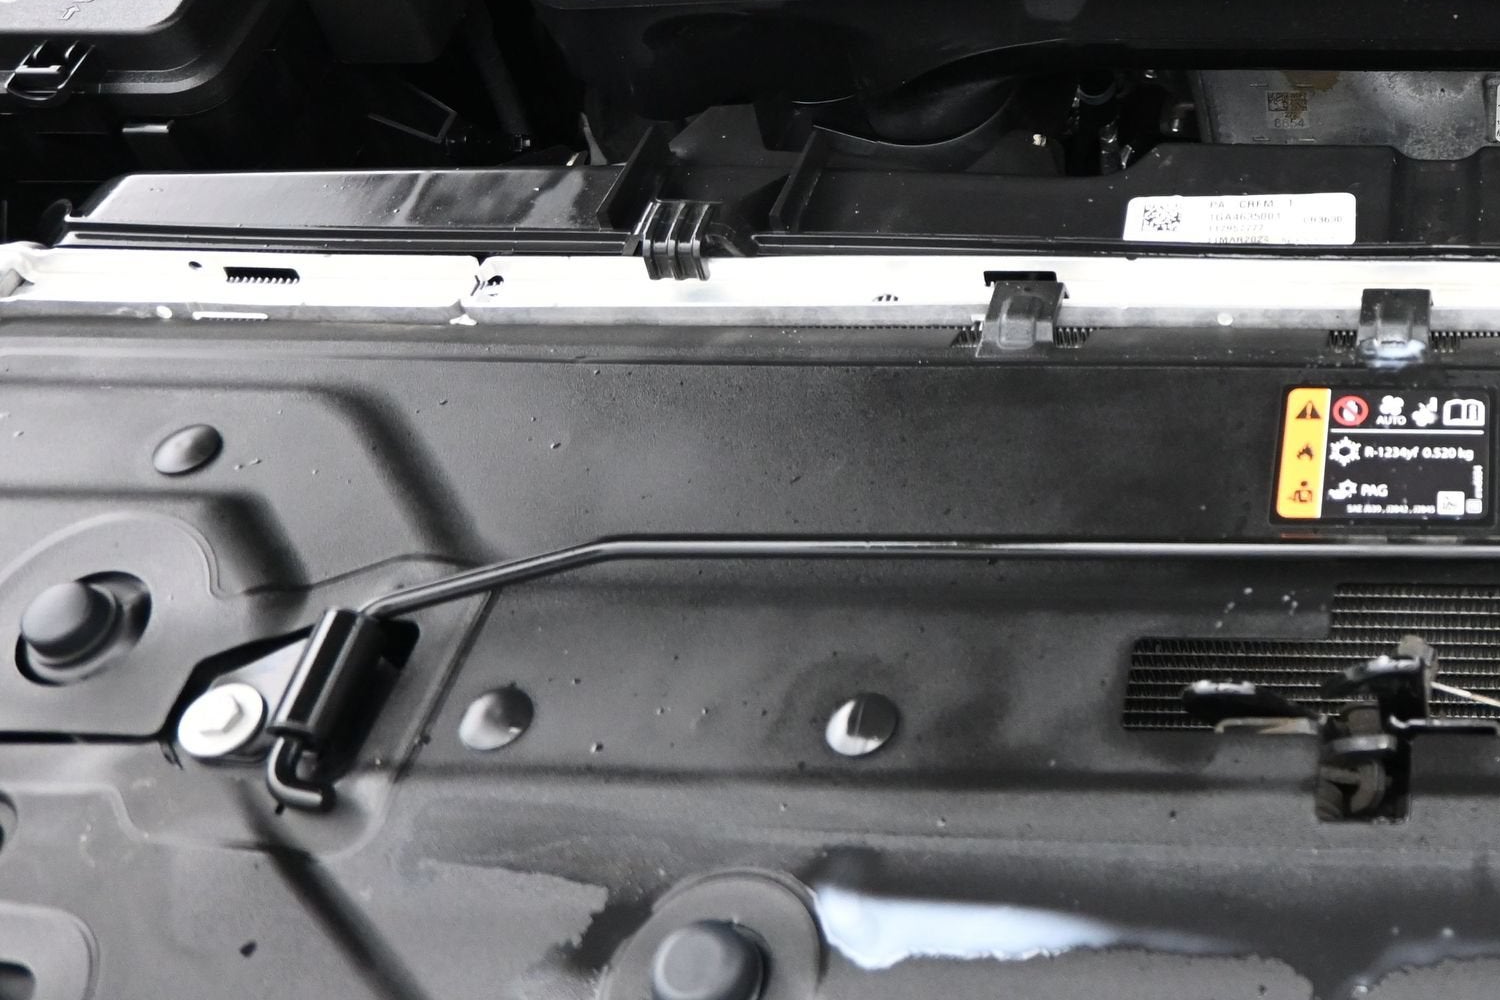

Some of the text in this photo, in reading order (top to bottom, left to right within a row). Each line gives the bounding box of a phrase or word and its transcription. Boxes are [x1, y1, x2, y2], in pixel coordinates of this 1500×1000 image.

[1376, 415, 1408, 426] AUTO
[1364, 446, 1475, 461] R-1234yf 0.520 kg
[1360, 483, 1389, 497] PAG
